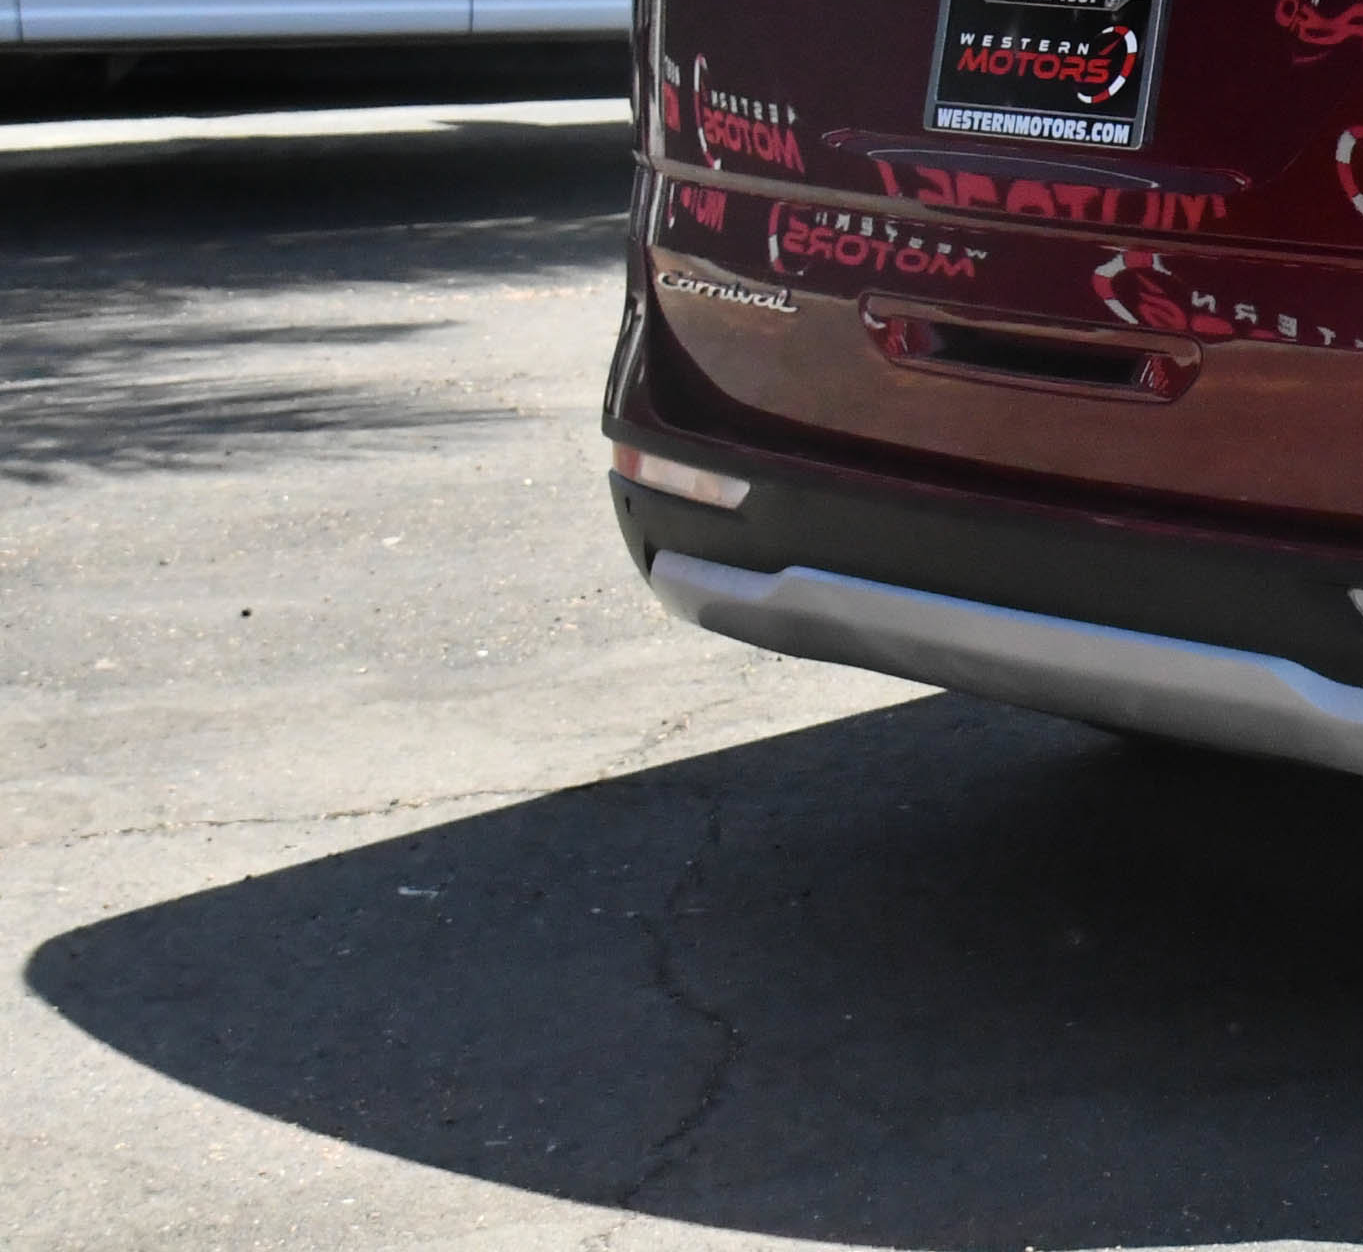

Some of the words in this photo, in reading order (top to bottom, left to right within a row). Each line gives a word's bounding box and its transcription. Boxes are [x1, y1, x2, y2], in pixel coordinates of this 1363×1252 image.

[959, 32, 1090, 55] WESTERN
[956, 47, 1112, 84] MOTORS
[936, 107, 1131, 145] WESTERNMOTORS.COM
[657, 271, 798, 313] Carnival
